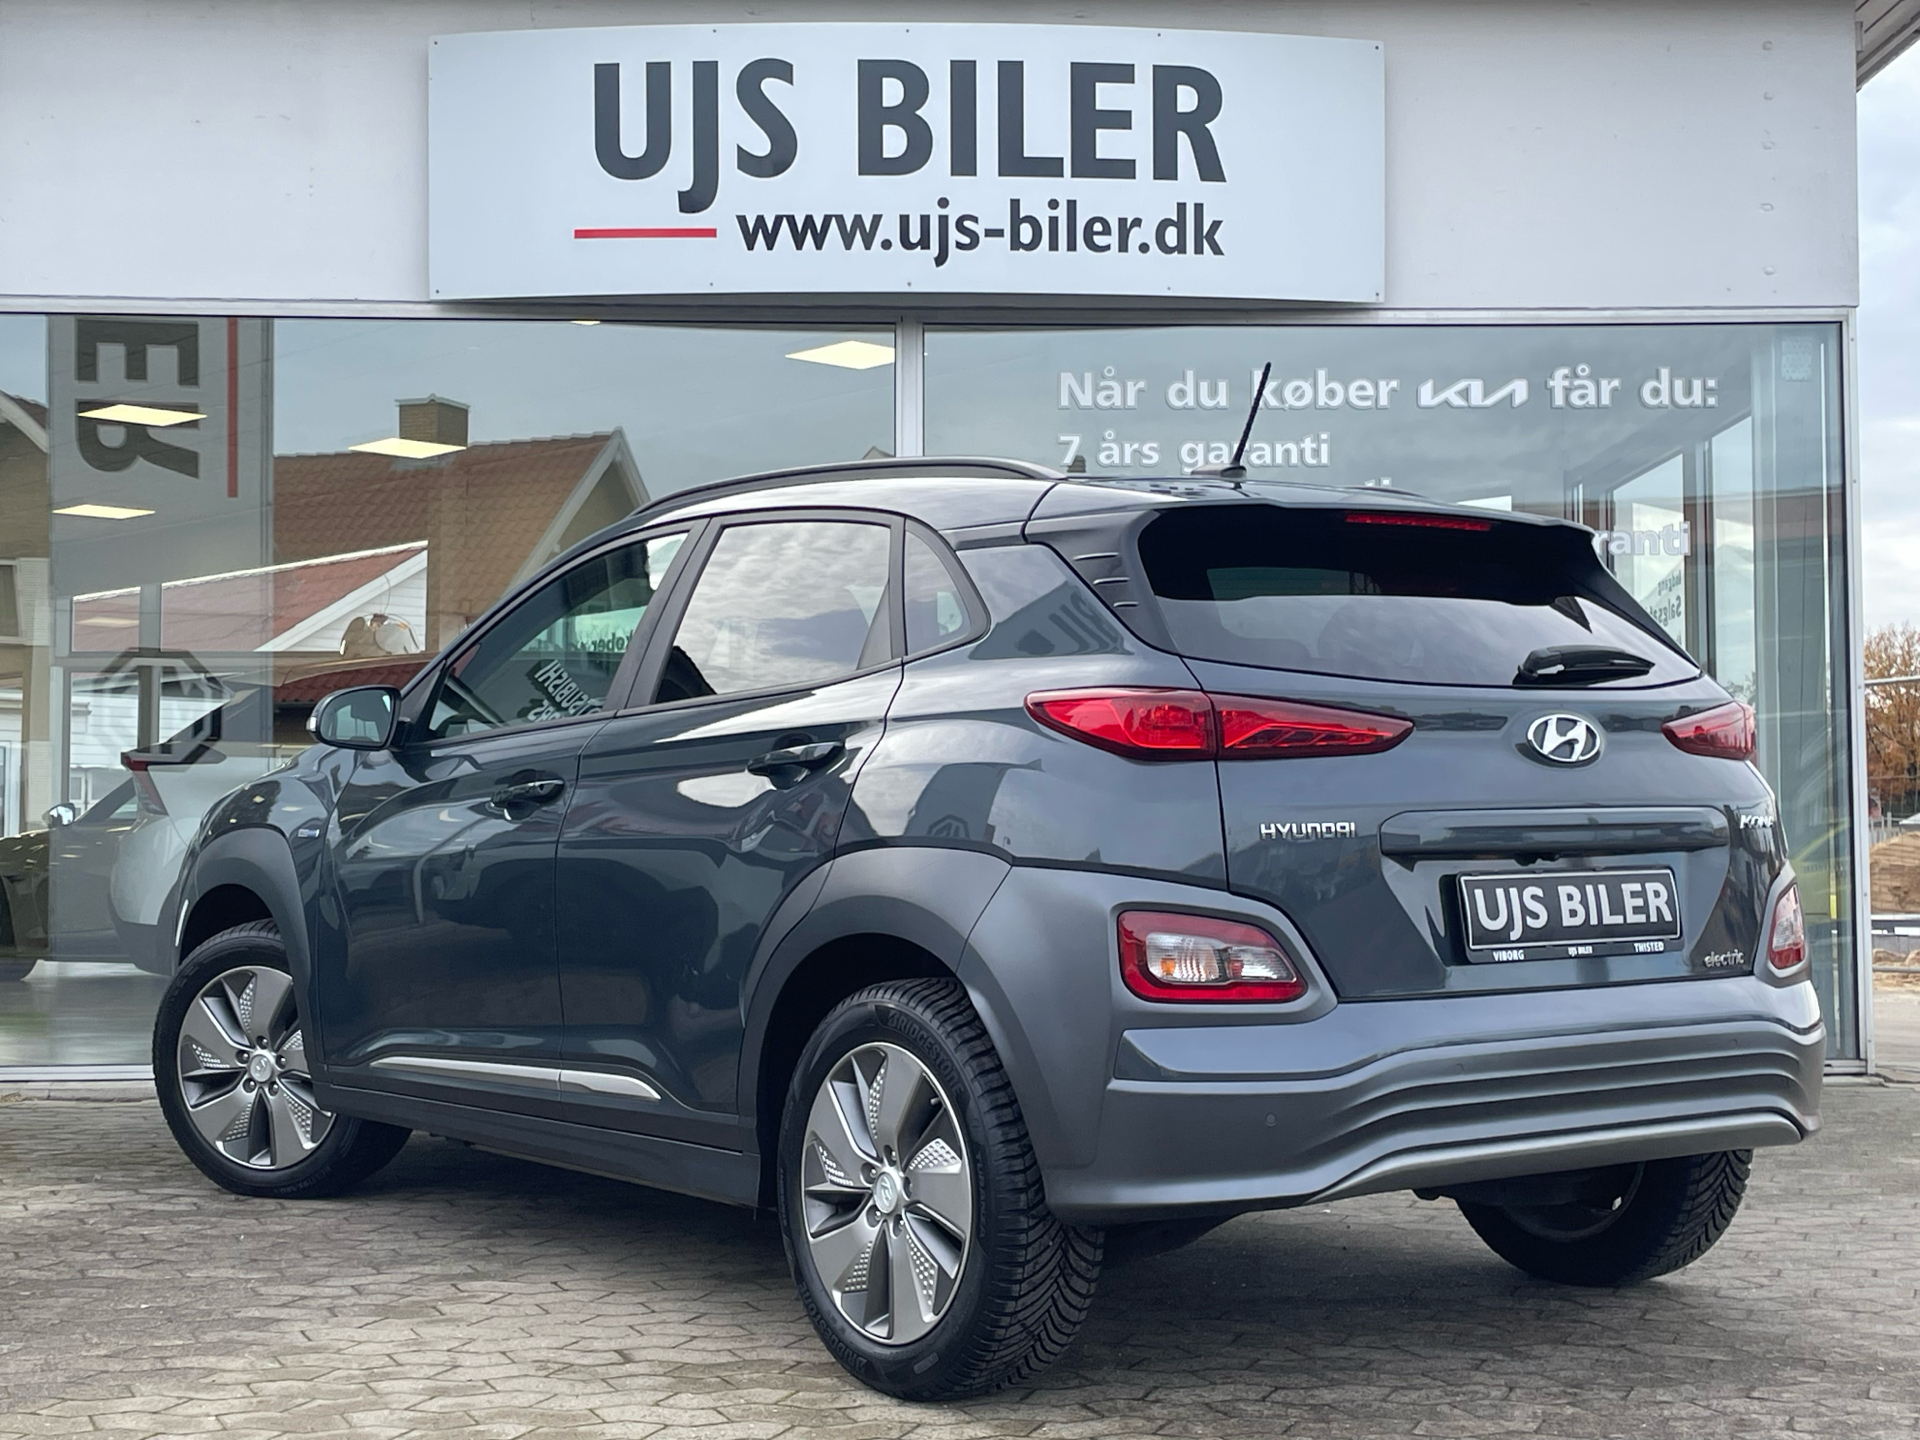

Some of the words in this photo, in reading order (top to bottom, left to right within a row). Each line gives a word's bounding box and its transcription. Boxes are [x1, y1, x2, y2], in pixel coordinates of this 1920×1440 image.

[593, 57, 798, 213] UJS
[857, 58, 1228, 183] BILER
[736, 197, 1225, 268] www.ujs-biler.dk
[1059, 365, 1146, 409] Når
[1167, 369, 1229, 409] du
[1252, 367, 1398, 410] køber
[1547, 363, 1621, 409] får
[1640, 366, 1718, 409] du:
[1059, 434, 1081, 466] 7
[1098, 429, 1160, 467] års
[1592, 521, 1690, 556] ranti
[1260, 822, 1356, 839] HYUNDAI
[1473, 886, 1548, 941] UJS
[1561, 881, 1673, 928] BILER
[1493, 949, 1525, 961] VIBORG
[1633, 941, 1664, 953] THISTED
[1704, 948, 1745, 968] electric
